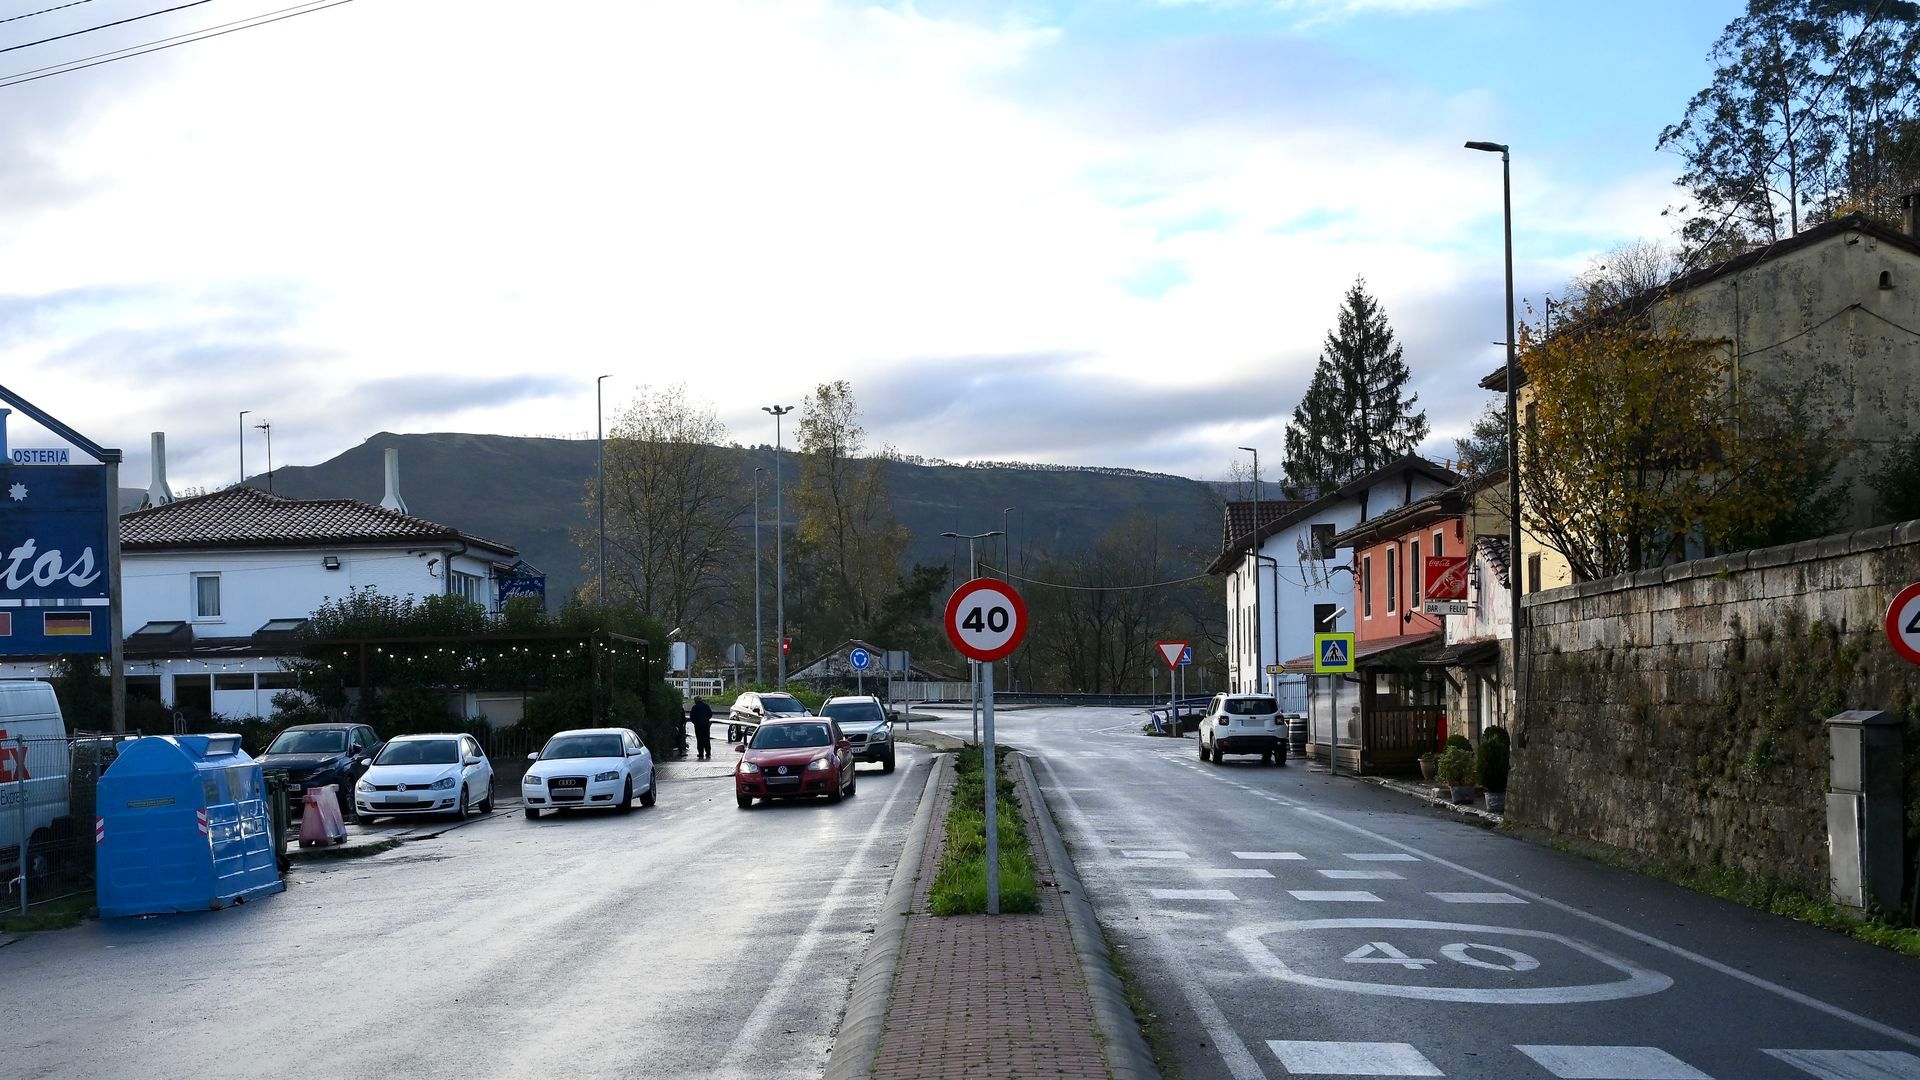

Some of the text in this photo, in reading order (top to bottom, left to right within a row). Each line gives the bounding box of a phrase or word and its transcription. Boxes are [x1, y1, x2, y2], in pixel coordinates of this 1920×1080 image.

[14, 450, 68, 463] OSTERIA
[0, 538, 101, 590] tos
[962, 606, 1010, 633] 40
[1343, 941, 1541, 971] 40
